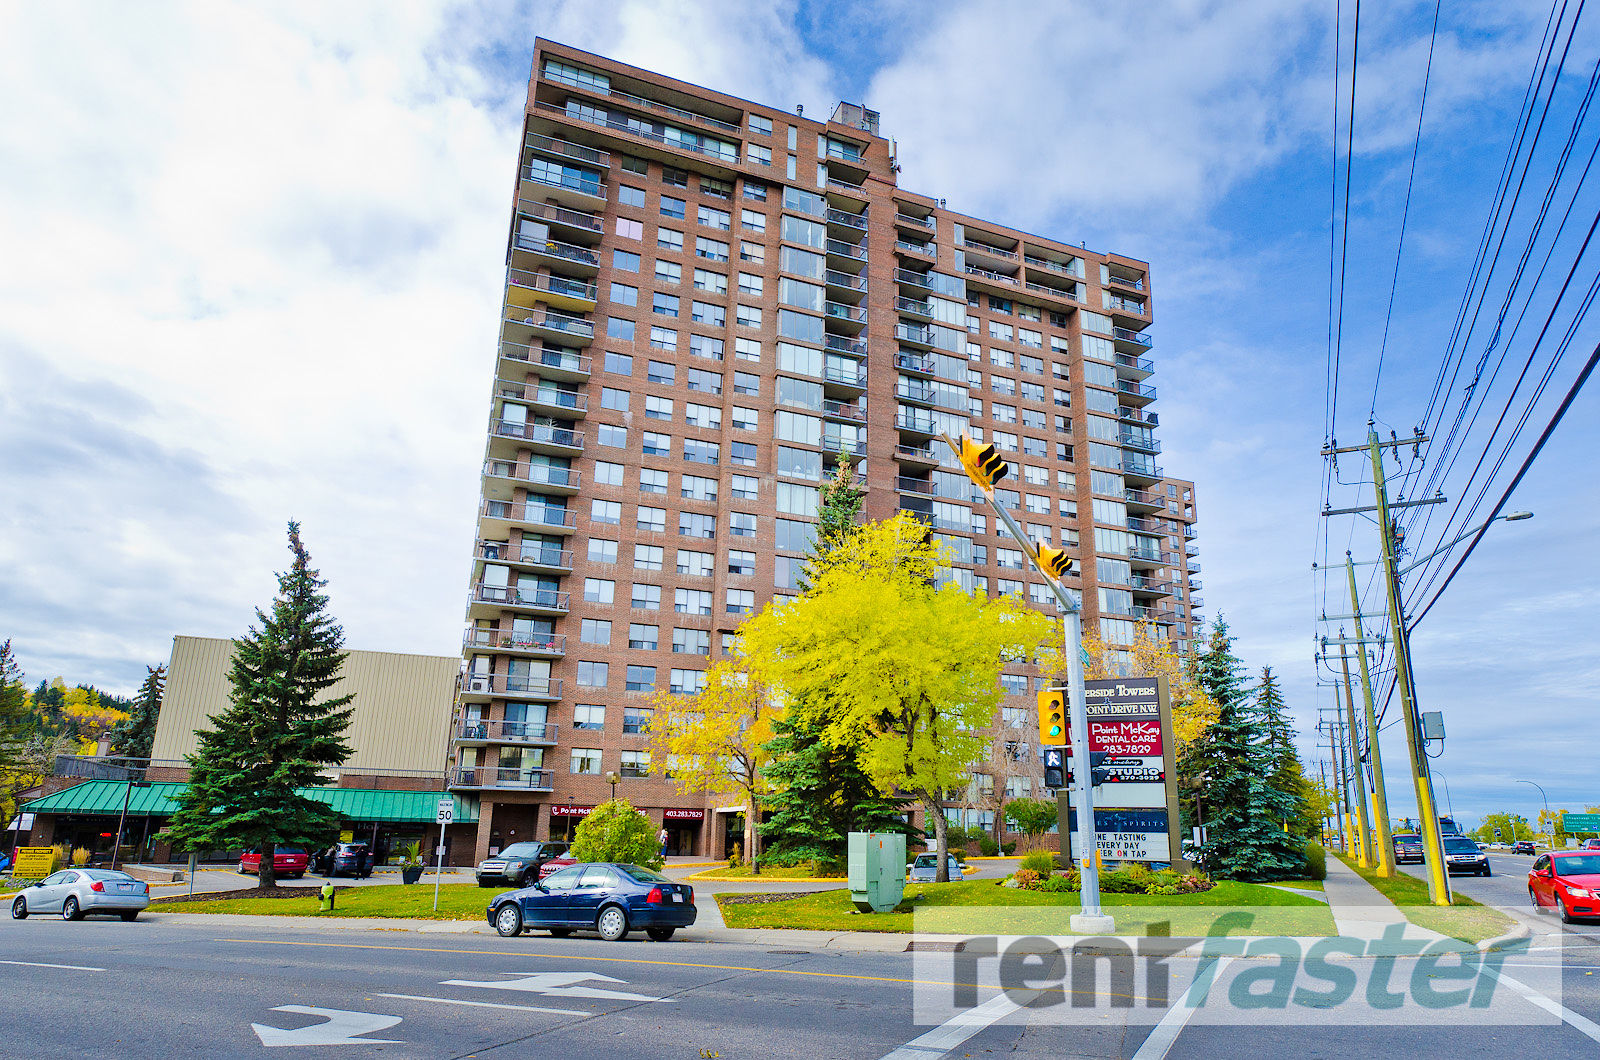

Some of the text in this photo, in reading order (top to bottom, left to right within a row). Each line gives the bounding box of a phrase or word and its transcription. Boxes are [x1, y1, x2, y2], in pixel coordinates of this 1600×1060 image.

[1085, 689, 1115, 697] ERSIDE
[1111, 705, 1139, 715] DRIVE
[1091, 722, 1160, 735] Point McKay
[1095, 735, 1157, 743] DENTAL CARE
[1102, 745, 1151, 753] 283-7829
[438, 810, 452, 820] 50
[1095, 833, 1146, 841] INE TASTING
[1096, 841, 1121, 849] EVERY
[1117, 849, 1127, 857] ON
